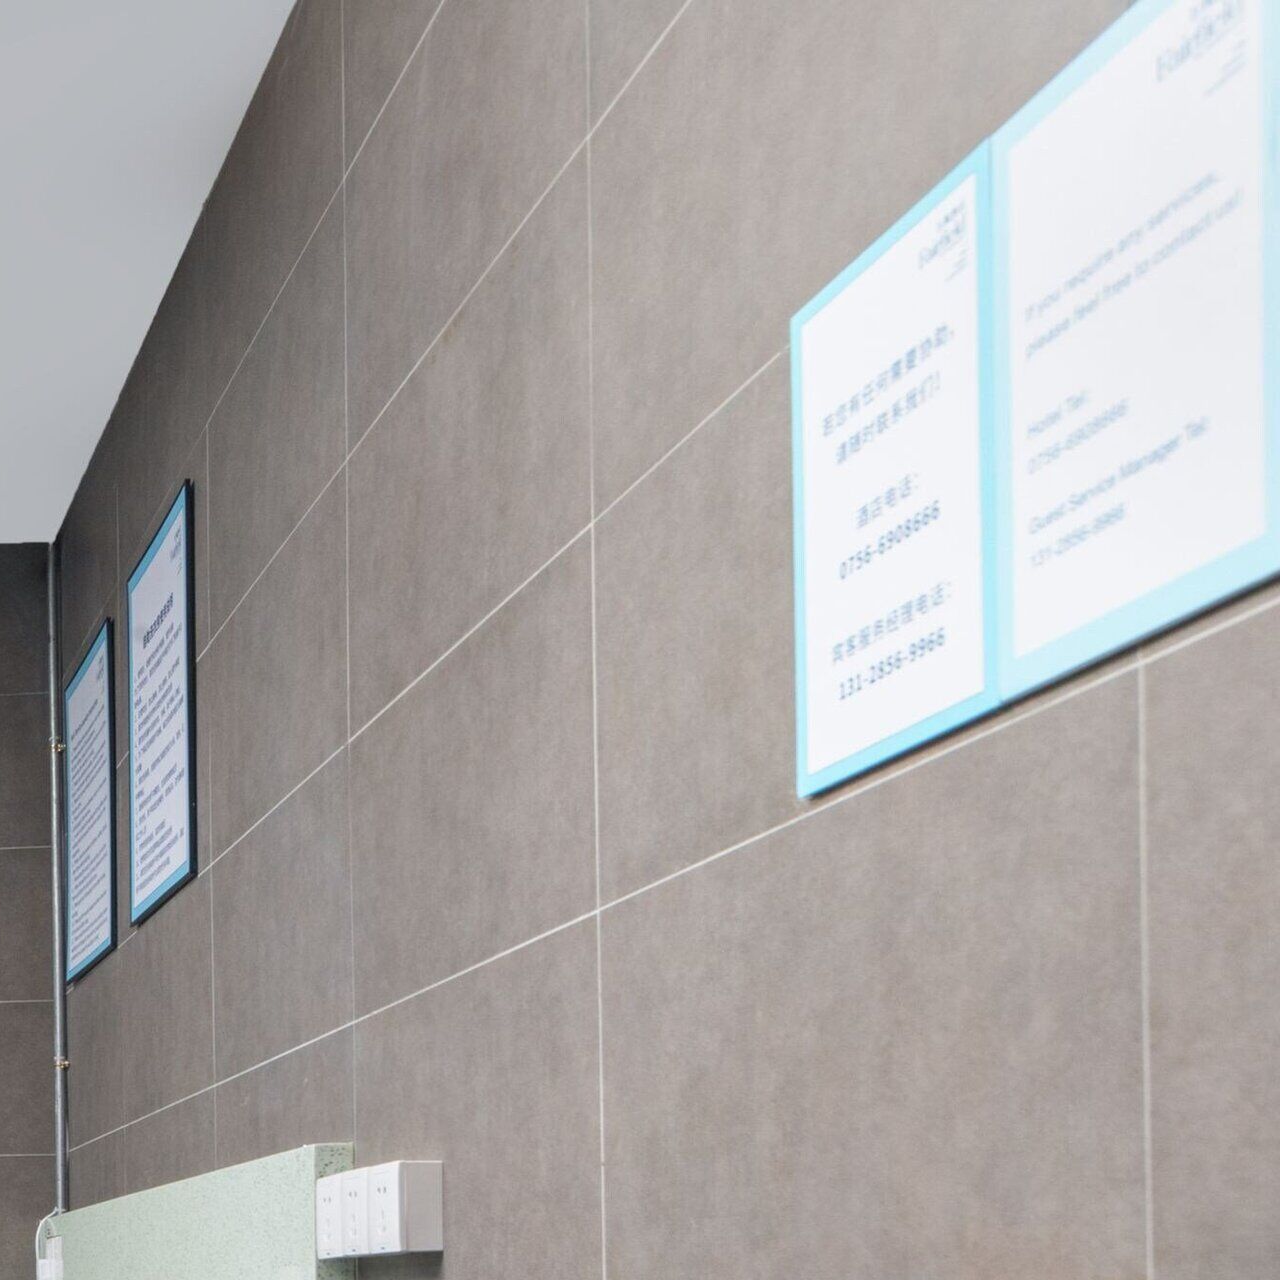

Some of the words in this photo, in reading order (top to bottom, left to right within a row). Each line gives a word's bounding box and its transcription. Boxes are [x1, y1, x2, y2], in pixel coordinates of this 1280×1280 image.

[1029, 500, 1067, 536] Guest
[1067, 474, 1117, 513] Service
[1118, 434, 1183, 482] Manager
[840, 499, 941, 580] 0756-6908666
[840, 627, 946, 701] 131-2856-9966
